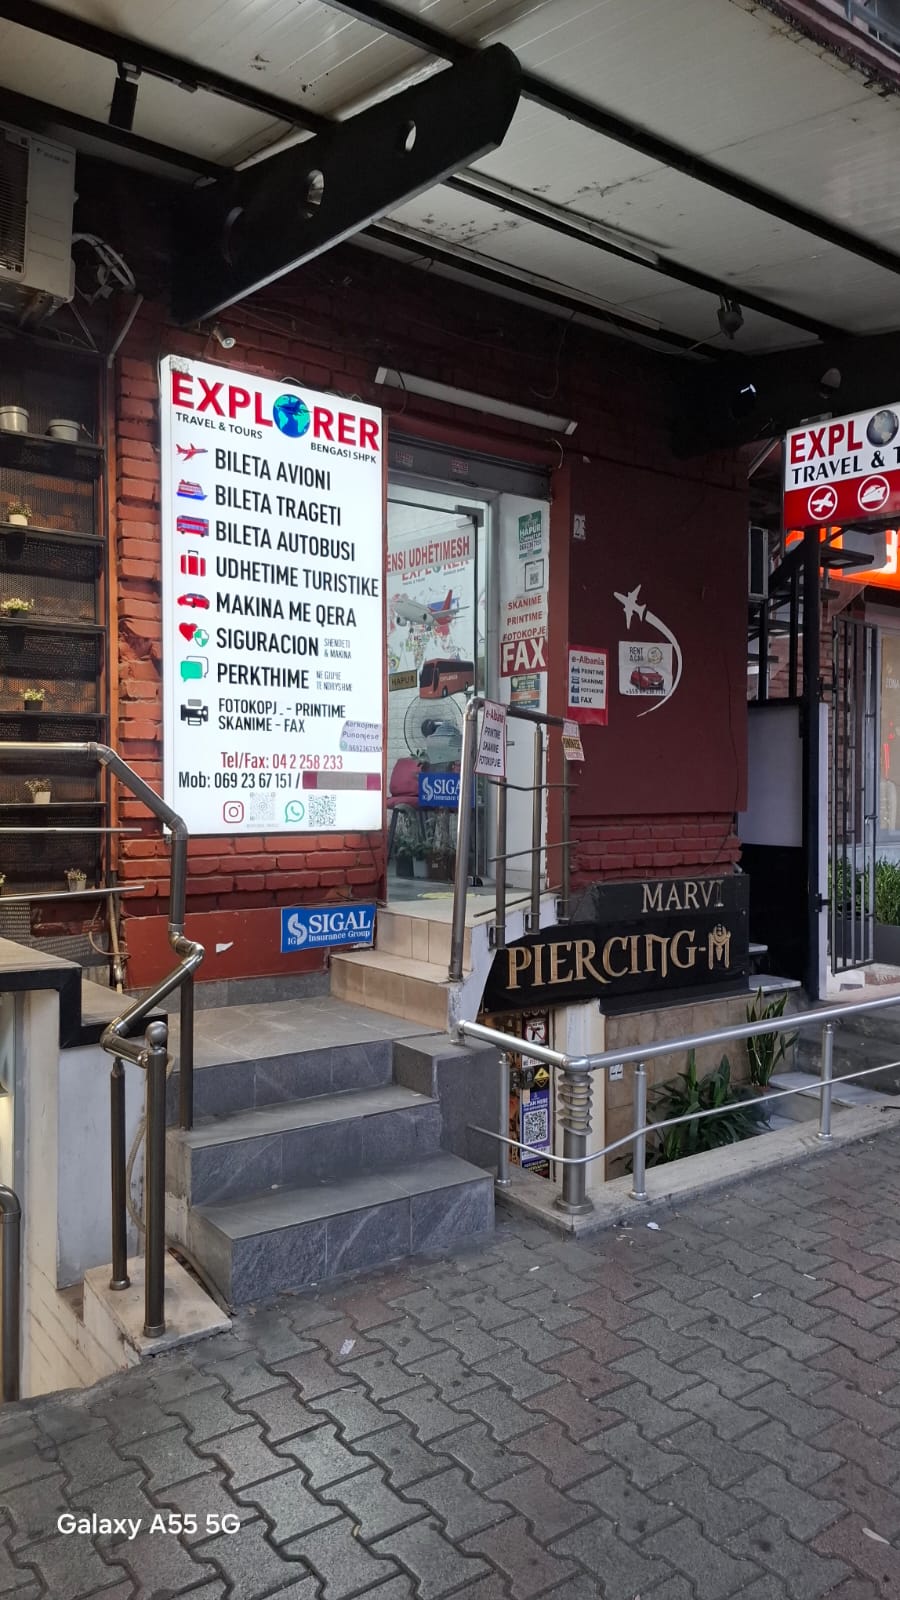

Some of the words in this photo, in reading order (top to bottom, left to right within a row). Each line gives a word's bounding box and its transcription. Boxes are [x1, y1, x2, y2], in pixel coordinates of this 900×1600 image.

[176, 412, 216, 430] TRAVEL
[219, 420, 226, 431] &
[229, 423, 263, 439] TOURS
[310, 442, 351, 459] BENGASI
[353, 452, 377, 464] SHPK
[215, 448, 271, 480] BILETA
[276, 461, 331, 491] AVIONI
[792, 455, 863, 485] TRAVEL
[870, 450, 885, 468] &
[215, 484, 272, 515] BILETA
[276, 496, 341, 527] TRAGETI
[216, 520, 272, 549] BILETA
[277, 531, 355, 562] AUTOBUSI
[216, 556, 299, 587] UDHETIME
[303, 568, 379, 598] TURISTIKE
[216, 592, 285, 620] MAKINA
[289, 601, 311, 622] ME
[316, 605, 357, 627] QERA
[507, 595, 542, 611] SKANIME
[506, 611, 543, 626] PRINTIME
[216, 627, 319, 657] SIGURACION
[503, 626, 546, 641] FOTOKOPJE
[330, 649, 351, 659] MAKINA
[502, 639, 546, 673] FAX
[572, 656, 604, 665] e-Albania
[217, 663, 310, 690] PERKTHIME
[219, 697, 284, 717] FOTOKOPJ
[295, 703, 346, 718] PRINTIME
[219, 715, 272, 732] SKANIME
[284, 718, 306, 733] FAX
[221, 752, 270, 769] Tel/Fax:
[272, 754, 287, 769] 04
[290, 755, 297, 769] 2
[300, 754, 321, 770] 258
[323, 754, 343, 770] 233
[179, 771, 211, 788] Mob:
[214, 772, 238, 789] 069
[241, 772, 255, 789] 23
[259, 773, 271, 789] 67
[275, 773, 292, 789] 151
[295, 772, 301, 789] /
[641, 879, 725, 913] MARVI
[309, 910, 371, 934] SIGAL
[288, 937, 296, 945] IG
[308, 932, 346, 942] Insurance
[348, 930, 370, 939] Group
